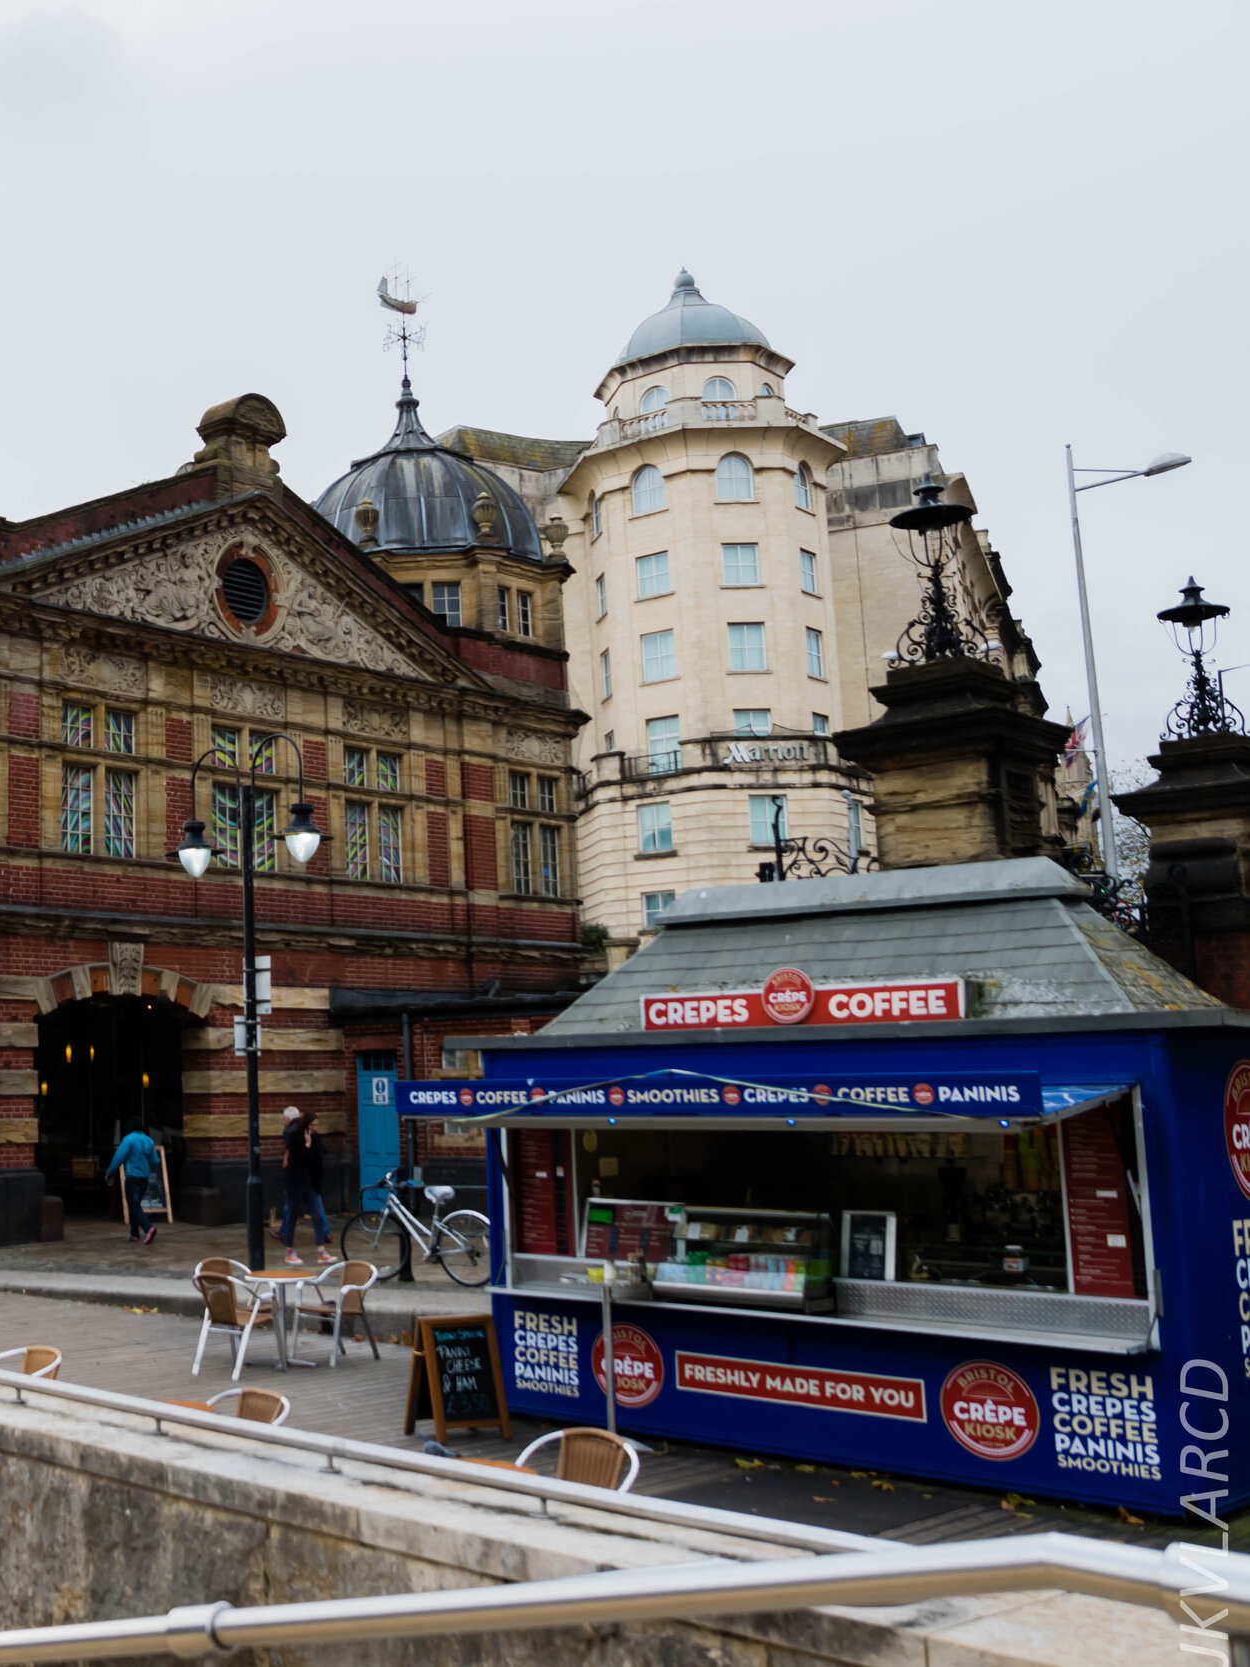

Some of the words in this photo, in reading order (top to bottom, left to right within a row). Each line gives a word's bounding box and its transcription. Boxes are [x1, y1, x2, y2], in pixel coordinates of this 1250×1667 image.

[723, 743, 810, 765] Marriott
[648, 998, 749, 1026] CREPES
[828, 989, 948, 1019] COFFEE
[768, 989, 808, 1004] CRÊPE
[409, 1091, 457, 1105] CREPES
[475, 1090, 528, 1105] COFFEE
[627, 1088, 720, 1104] SMOOTHIES
[743, 1087, 809, 1103] CREPES
[837, 1087, 910, 1103] COFFEE
[938, 1085, 1021, 1103] PANINIS
[513, 1310, 578, 1337] FRESH
[514, 1330, 578, 1353] CREPES
[446, 1357, 482, 1374] CHEESE
[514, 1346, 578, 1370] COFFEE
[456, 1375, 478, 1392] HAM
[514, 1361, 579, 1386] PANINIS
[616, 1377, 647, 1391] IOSK
[683, 1363, 761, 1388] FRESHLY
[765, 1373, 821, 1397] MADE
[824, 1381, 865, 1402] FOR
[869, 1385, 915, 1409] YOU
[956, 1367, 1016, 1394] BRISTOL
[1049, 1366, 1155, 1401] FRESH
[515, 1377, 580, 1398] SMOOTHIES
[952, 1398, 1028, 1427] CRÊPE
[1051, 1391, 1157, 1423] CREPES
[964, 1422, 1017, 1441] KIOSK
[1053, 1412, 1159, 1444] COFFEE
[1054, 1433, 1161, 1466] PANINIS
[1057, 1454, 1162, 1480] SMOOTHIES
